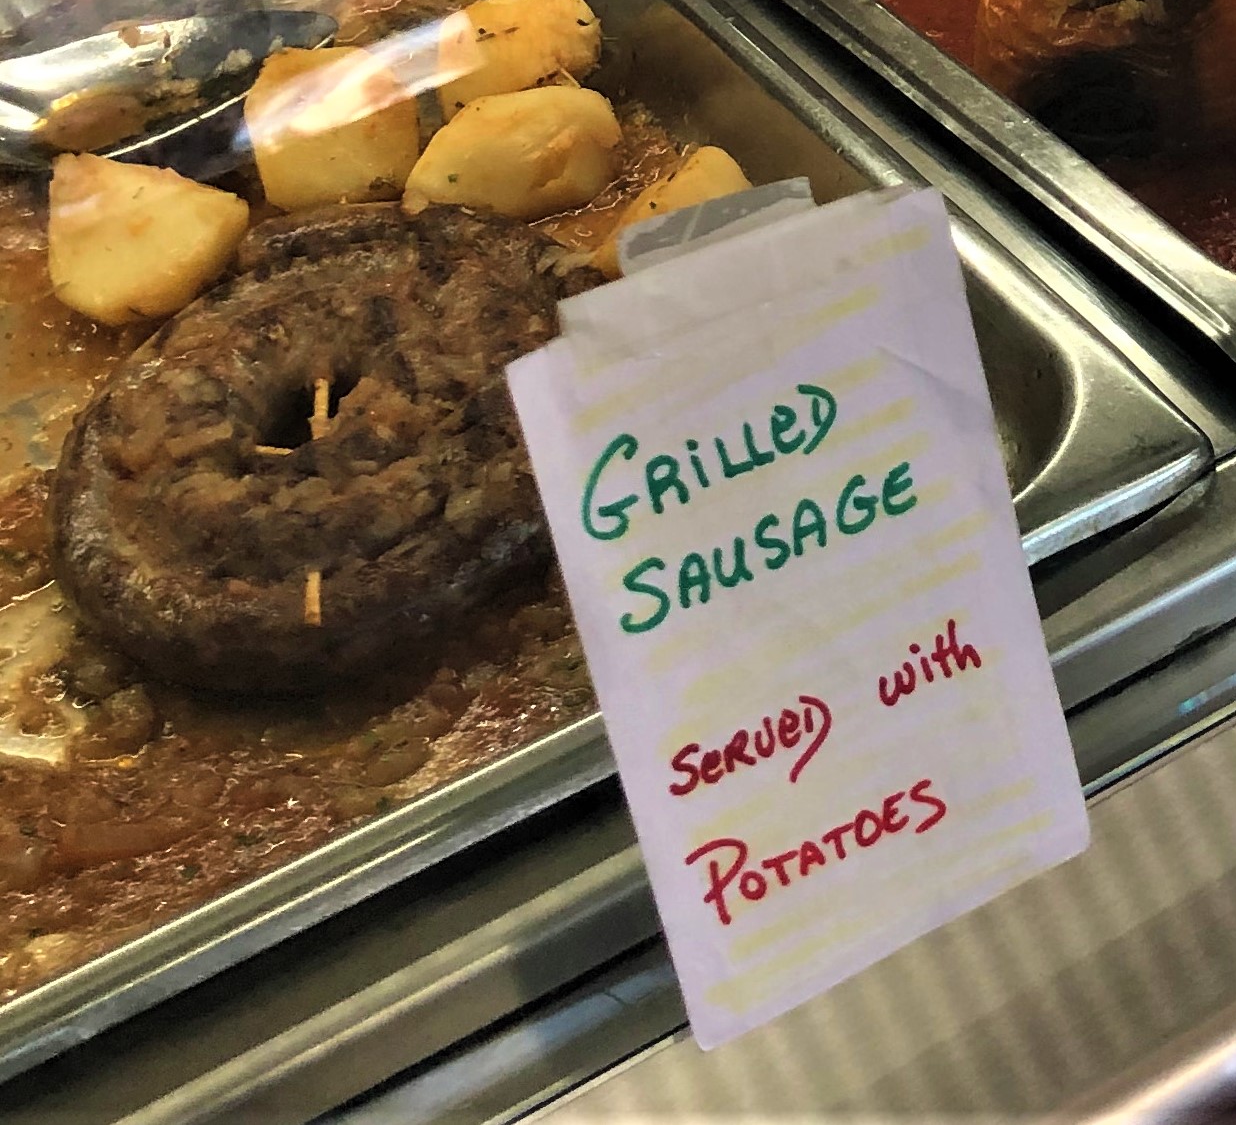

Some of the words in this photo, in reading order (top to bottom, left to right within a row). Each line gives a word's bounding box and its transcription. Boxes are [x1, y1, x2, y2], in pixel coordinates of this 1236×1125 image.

[620, 461, 918, 634] SAUSAGE
[878, 619, 982, 707] with
[685, 778, 948, 926] POTATOES
